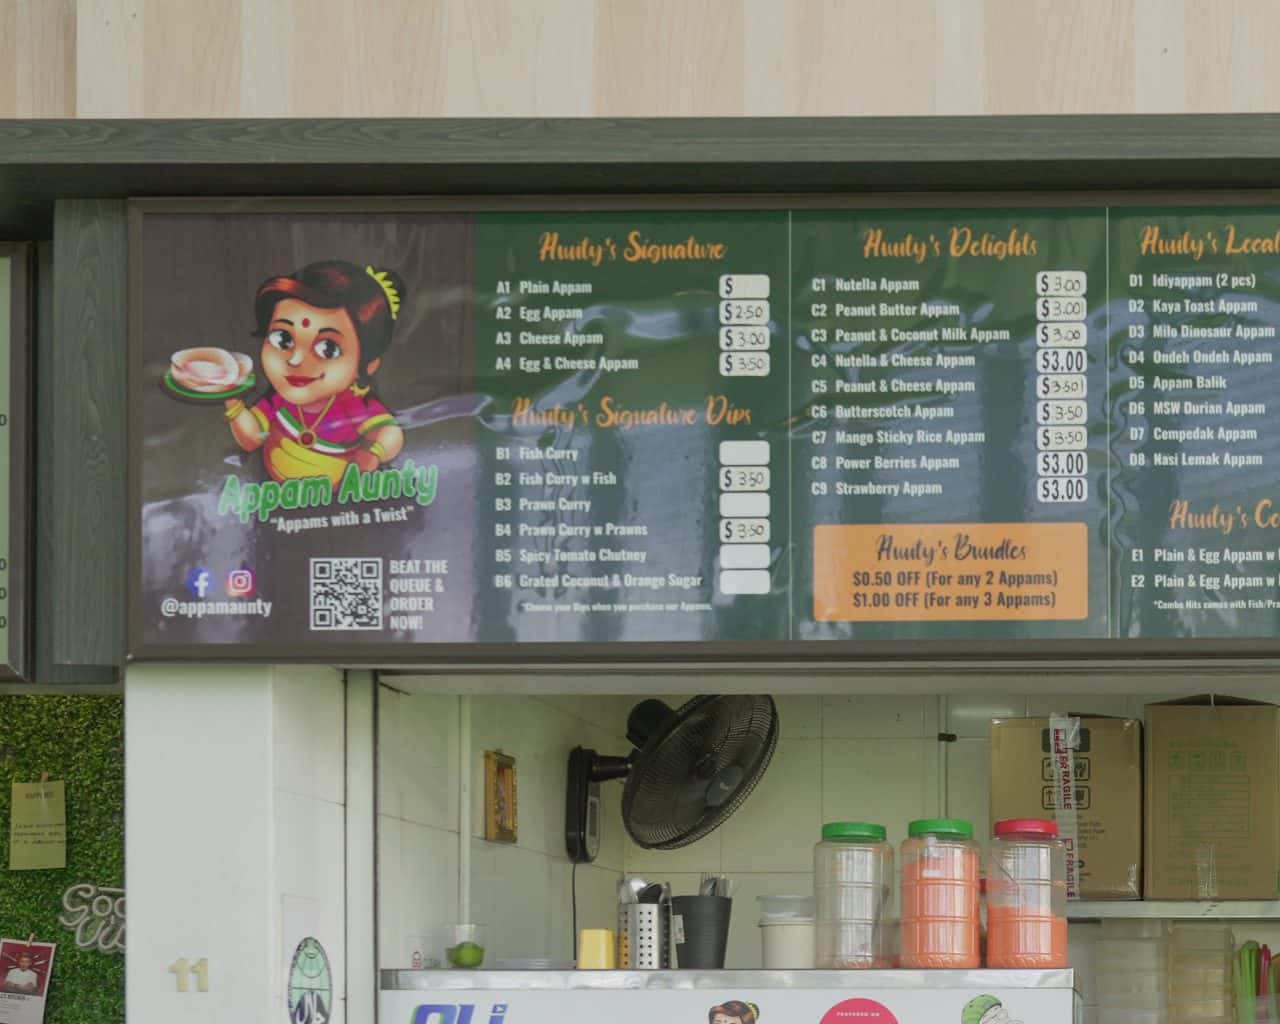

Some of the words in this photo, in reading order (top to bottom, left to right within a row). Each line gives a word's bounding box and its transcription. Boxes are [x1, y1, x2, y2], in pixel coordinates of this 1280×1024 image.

[624, 230, 728, 263] Signature
[949, 226, 1038, 260] Delights
[496, 281, 510, 294] A1
[520, 281, 549, 294] Plain
[552, 281, 592, 296] Appam
[812, 279, 826, 292] C1
[836, 278, 877, 292] Nutella
[879, 278, 920, 294] Appam
[1129, 275, 1143, 287] D1
[1153, 274, 1213, 289] Idiyappam
[1216, 273, 1228, 288] (2
[1231, 273, 1256, 289] pcs)
[496, 307, 511, 319] A2
[520, 307, 540, 321] Egg
[544, 306, 583, 321] Appam
[1129, 326, 1145, 338] D3
[1153, 325, 1178, 338] Milo
[1181, 325, 1232, 338] Dinosaur
[1235, 325, 1276, 340] Appam
[496, 358, 511, 370] A4
[520, 357, 540, 372] Egg
[543, 358, 552, 370] &
[555, 357, 595, 370] Cheese
[599, 357, 638, 372] Appam
[1041, 351, 1084, 371] $3.00
[596, 396, 696, 429] Signature
[705, 395, 752, 425] Dips
[1129, 402, 1145, 415] D6
[1154, 402, 1181, 415] MSW
[1184, 401, 1223, 415] Durian
[1226, 401, 1266, 417] Appam
[812, 432, 827, 444] C7
[836, 431, 873, 447] Mango
[877, 430, 913, 445] Sticky
[917, 430, 942, 443] Rice
[945, 430, 985, 446] Appam
[218, 474, 332, 523] Appam
[338, 459, 439, 506] Aunty
[811, 483, 827, 495] C9
[836, 482, 900, 497] Strawberry
[903, 482, 943, 497] Appam
[1041, 479, 1084, 500] $3.00
[332, 511, 359, 527] with
[361, 513, 371, 525] a
[953, 533, 1027, 562] Bundles
[495, 550, 511, 562] B5
[520, 550, 551, 565] Spicy
[554, 550, 596, 562] Tomato
[599, 549, 647, 565] Chutney
[390, 560, 422, 574] BEAT
[424, 560, 448, 574] THE
[390, 578, 432, 593] QUEUE
[435, 579, 444, 592] &
[853, 571, 892, 587] $0.50
[897, 571, 921, 586] OFF
[925, 570, 953, 588] (For
[957, 575, 981, 588] any
[985, 571, 994, 585] 2
[999, 570, 1058, 588] Appams)
[1131, 575, 1145, 587] E2
[1154, 575, 1185, 587] Plain
[1188, 575, 1196, 587] &
[1200, 574, 1220, 590] Egg
[1223, 574, 1263, 590] Appam
[1266, 577, 1275, 587] w
[161, 598, 272, 617] @appamaunty
[390, 597, 434, 611] ORDER
[390, 616, 423, 630] NOW!
[1066, 854, 1076, 898] FRAGILE
[168, 957, 209, 992] 11
